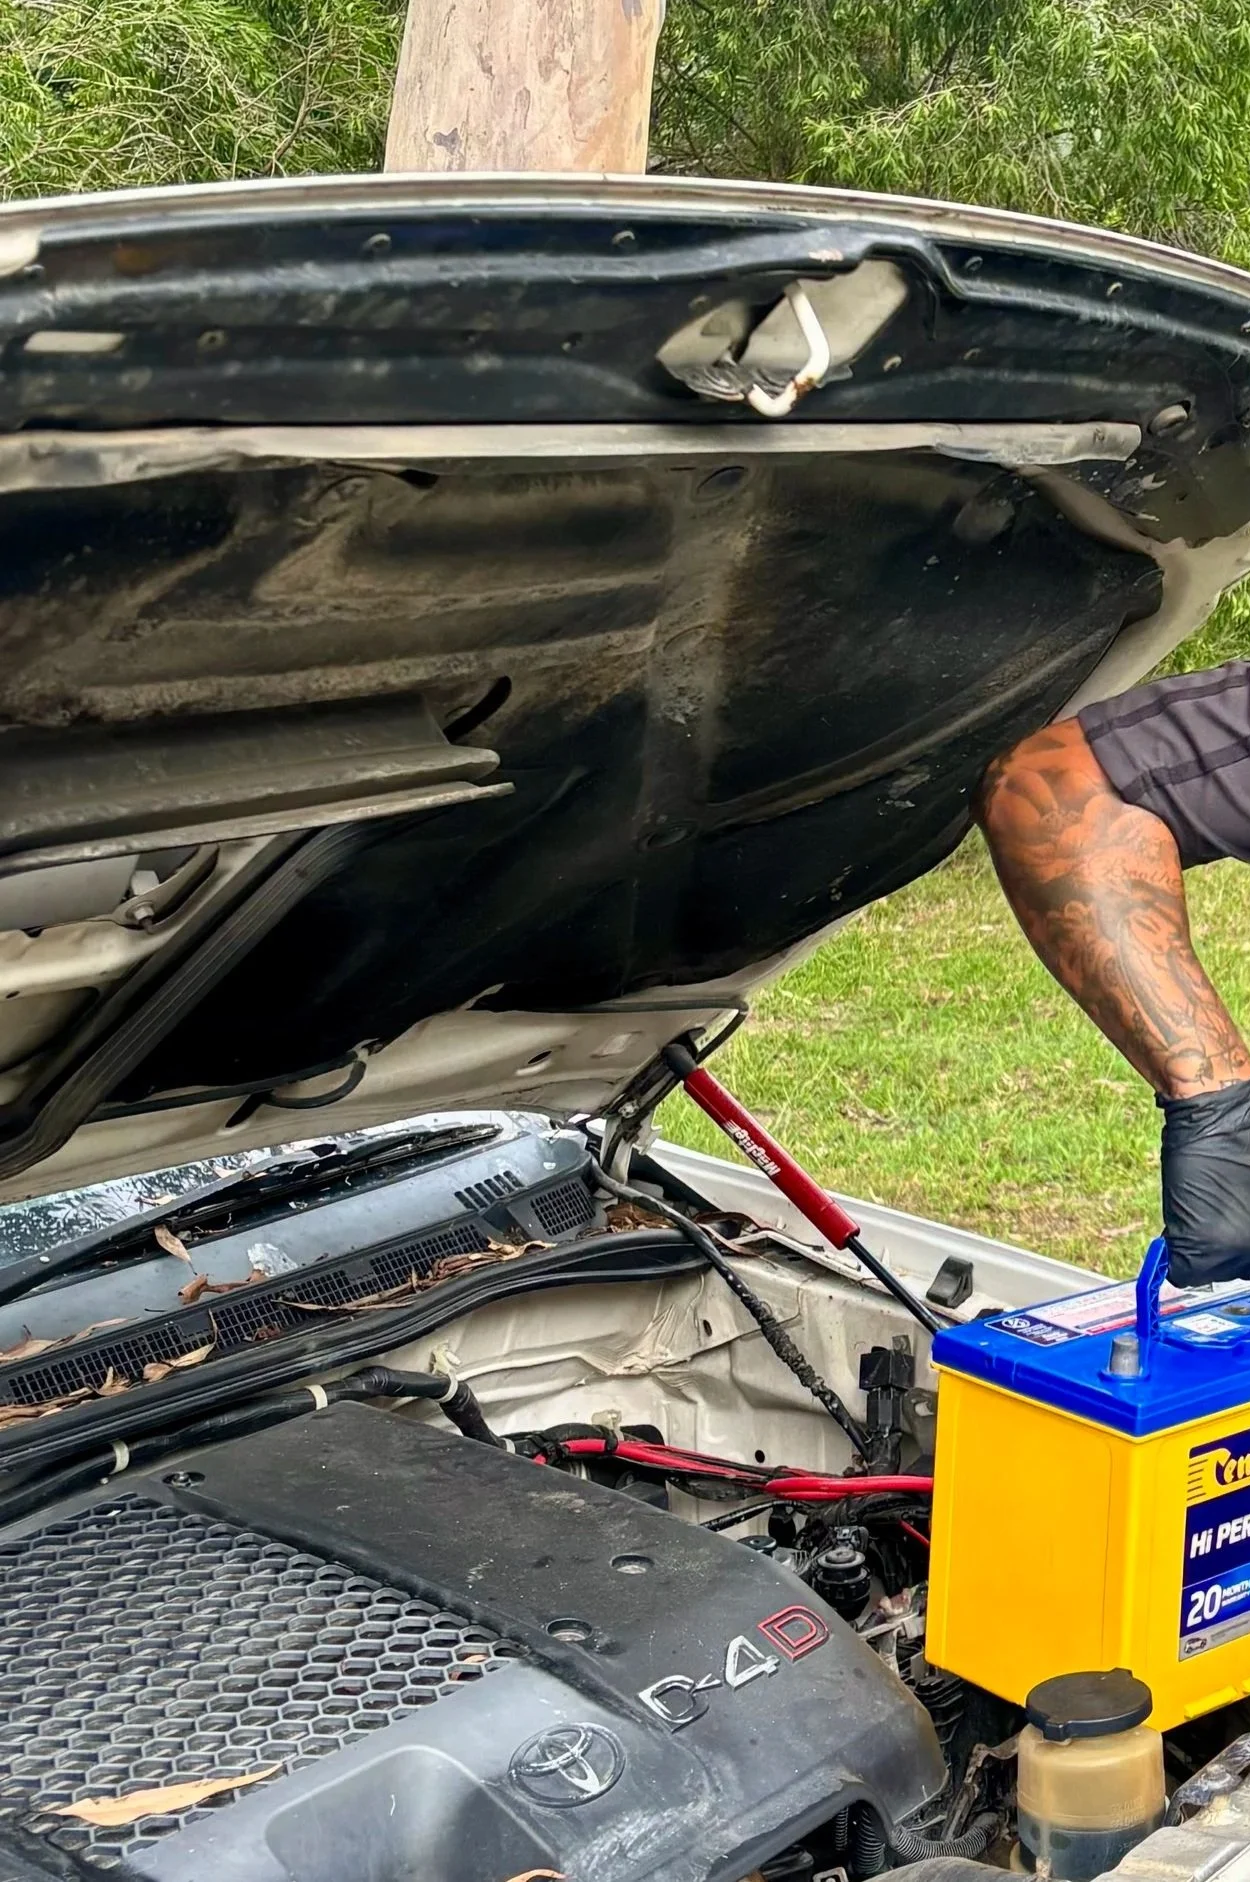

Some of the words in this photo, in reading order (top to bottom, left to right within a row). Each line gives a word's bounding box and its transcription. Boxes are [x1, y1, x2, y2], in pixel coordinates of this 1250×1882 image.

[1190, 1527, 1214, 1558] Hi
[1186, 1584, 1222, 1628] 20
[638, 1605, 832, 1734] D-4D
